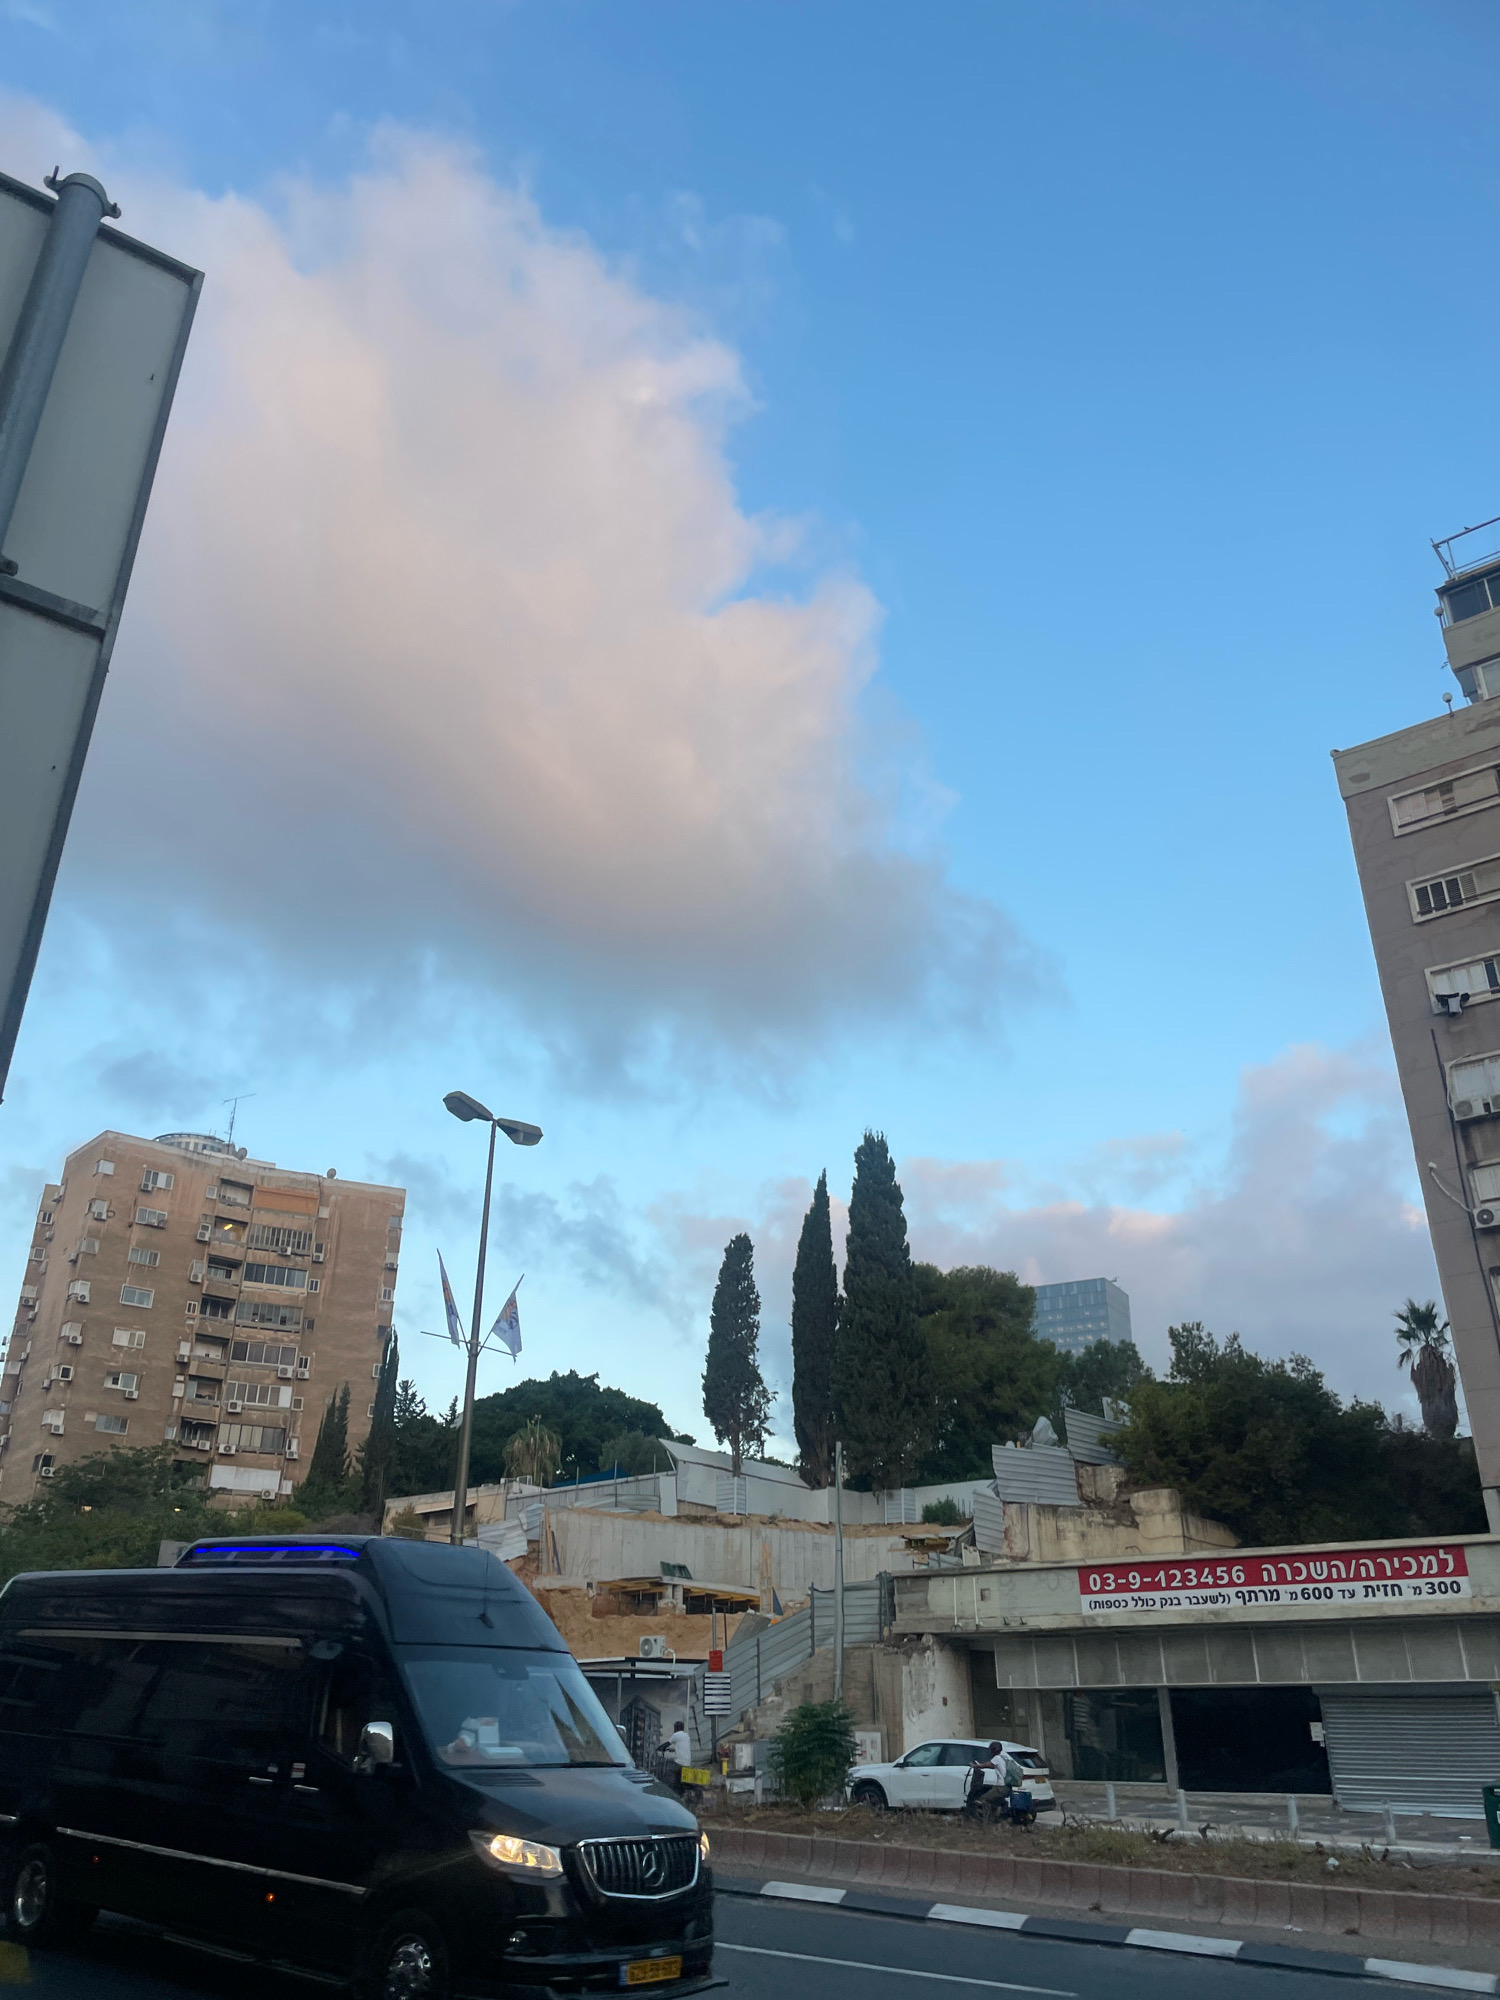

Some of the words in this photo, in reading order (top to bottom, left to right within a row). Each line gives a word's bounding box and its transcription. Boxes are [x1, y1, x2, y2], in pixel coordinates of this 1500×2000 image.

[1261, 1549, 1455, 1582] למכירה/השכרה
[1089, 1565, 1245, 1591] 03-9-123456
[1300, 1586, 1334, 1601] 600
[1337, 1588, 1356, 1599] עד
[1363, 1583, 1403, 1598] חזית
[1425, 1580, 1461, 1596] 300
[1131, 1596, 1156, 1608] כולל
[1160, 1596, 1182, 1609] בנק
[1185, 1592, 1231, 1606] (לשעבר
[1235, 1588, 1281, 1606] מרתף
[1088, 1599, 1129, 1611] כספות)
